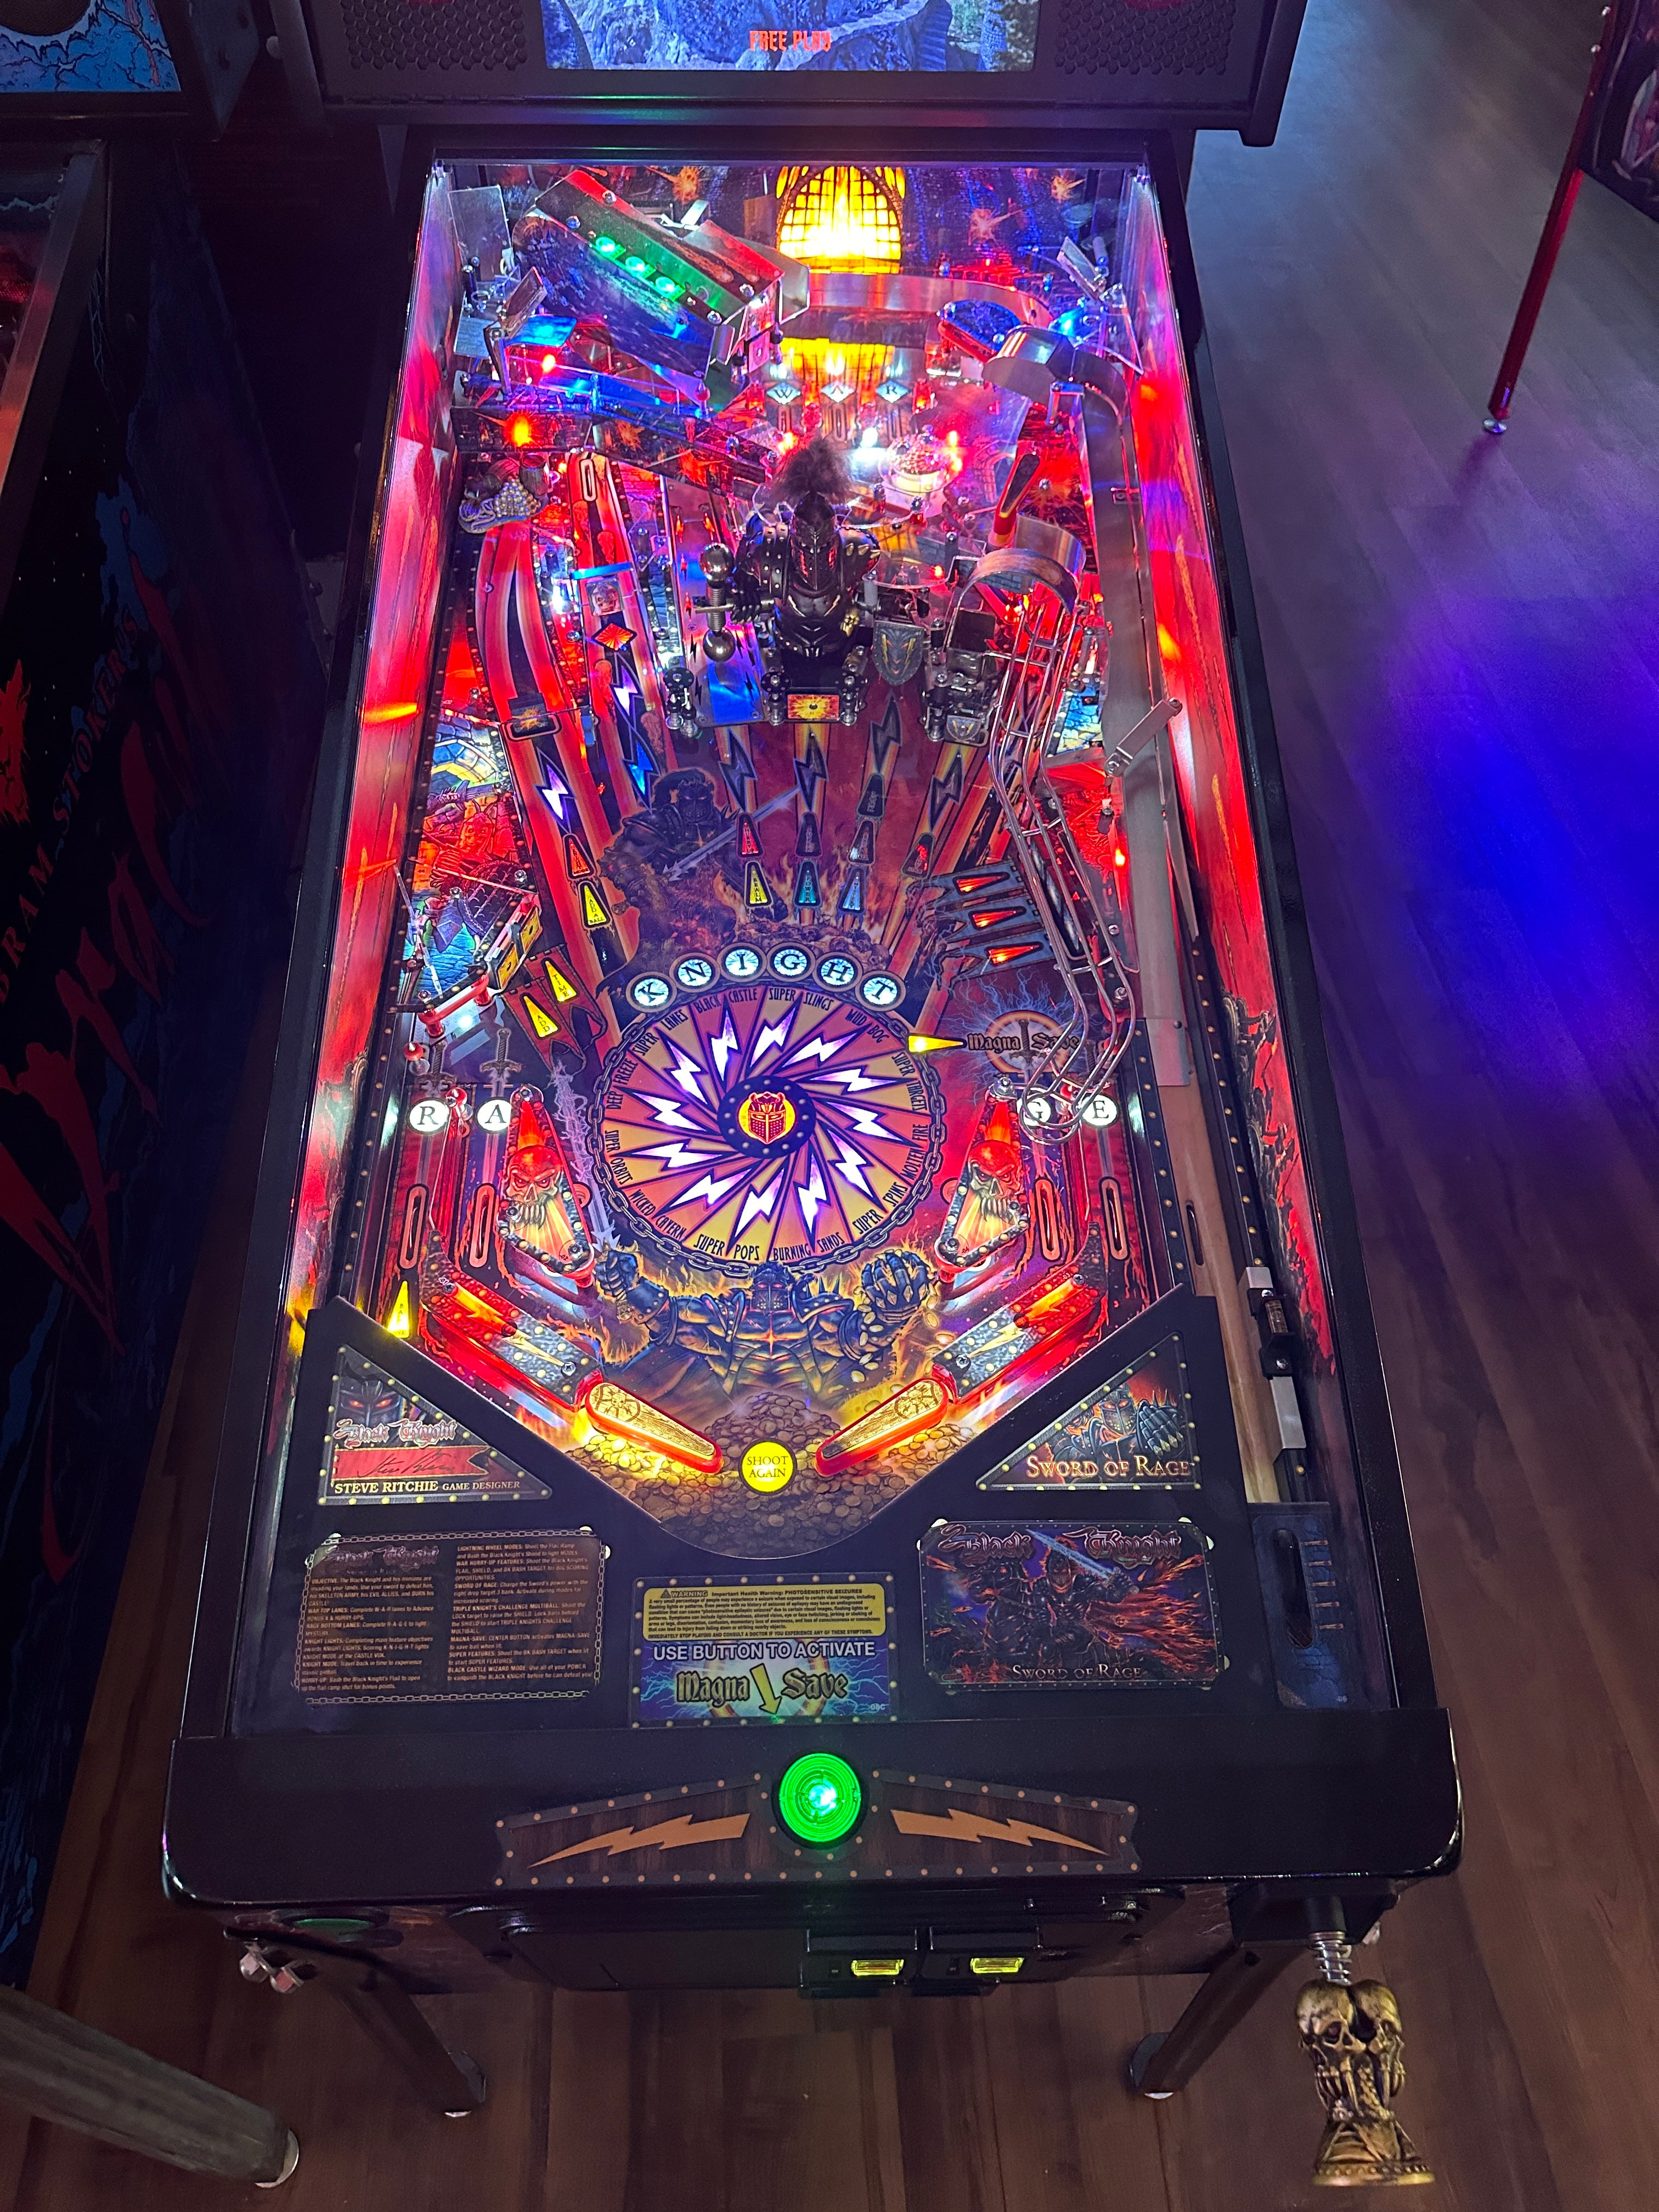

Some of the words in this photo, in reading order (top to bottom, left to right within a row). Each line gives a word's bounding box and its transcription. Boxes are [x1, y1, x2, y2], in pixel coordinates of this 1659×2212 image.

[749, 30, 787, 52] FREE
[793, 30, 831, 52] PLAY
[753, 878, 762, 902] REALM
[552, 974, 569, 998] TIME
[693, 994, 722, 1014] BLACK
[728, 988, 758, 1003] CASTLE
[769, 988, 796, 1001] SUPER
[803, 992, 834, 1011] SLINGS
[537, 1014, 550, 1032] ADD
[631, 1032, 659, 1056] SUPER
[660, 1009, 689, 1031] LANES
[845, 1008, 867, 1026] MUD
[867, 1024, 890, 1043] BOG
[967, 1033, 1021, 1054] Magna
[613, 1058, 639, 1085] FREEZE
[891, 1052, 915, 1076] SUPER
[906, 1081, 927, 1111] TARGETS
[606, 1091, 623, 1110] DEEP
[605, 1130, 620, 1153] SUPER
[912, 1124, 928, 1142] FIRE
[611, 1158, 633, 1185] ORBITS
[900, 1148, 925, 1181] MOLTEN
[629, 1189, 656, 1216] WICKED
[656, 1215, 686, 1239] CAVERN
[852, 1209, 884, 1234] SUPER
[882, 1182, 909, 1207] SPINS
[693, 1234, 725, 1256] SUPER
[733, 1244, 759, 1261] POPS
[773, 1243, 811, 1261] BURNING
[817, 1232, 845, 1252] SANDS
[333, 1419, 390, 1449] Black
[387, 1418, 458, 1448] Knight
[747, 1456, 789, 1465] SHOOT
[749, 1468, 786, 1477] AGAIN
[1027, 1455, 1098, 1478] SWORD
[1103, 1460, 1128, 1477] OF
[1134, 1454, 1192, 1477] RAGE
[334, 1482, 379, 1494] STEVE
[382, 1481, 438, 1493] RITCHIE
[442, 1482, 470, 1491] GAME
[472, 1481, 521, 1490] DESIGNER
[938, 1525, 1034, 1567] Black
[1063, 1526, 1181, 1569] Knight
[653, 1645, 688, 1660] USE
[692, 1644, 763, 1660] BUTTON
[767, 1643, 792, 1659] TO
[795, 1642, 876, 1658] ACTIVATE
[1012, 1664, 1068, 1679] SWORD
[1074, 1668, 1093, 1679] OF
[1098, 1663, 1142, 1679] RAGE
[676, 1671, 751, 1708] Magna
[781, 1668, 848, 1700] Save
